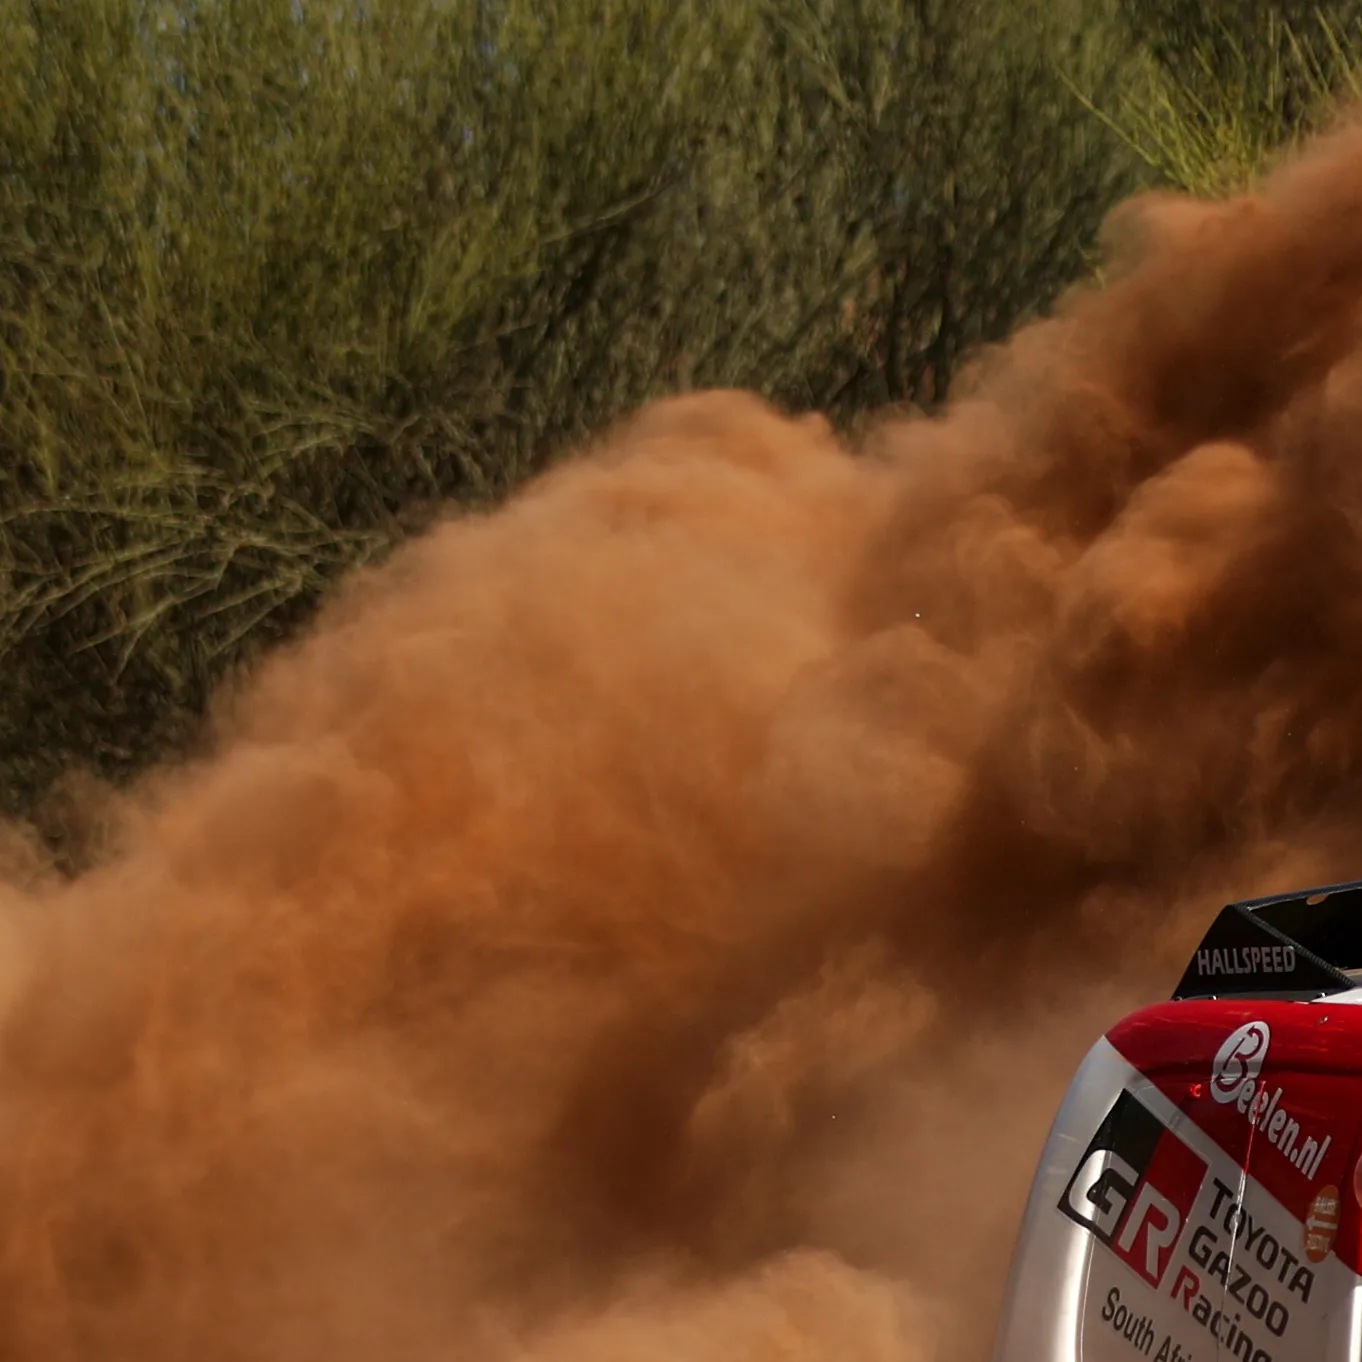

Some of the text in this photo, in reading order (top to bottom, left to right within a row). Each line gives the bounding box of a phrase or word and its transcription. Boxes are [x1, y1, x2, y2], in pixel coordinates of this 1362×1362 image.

[1198, 945, 1296, 975] HALLSPEED
[1069, 1149, 1181, 1280] GR
[1209, 1177, 1315, 1304] TOYOTA
[1101, 1287, 1156, 1357] South
[1188, 1225, 1290, 1338] GAZOO
